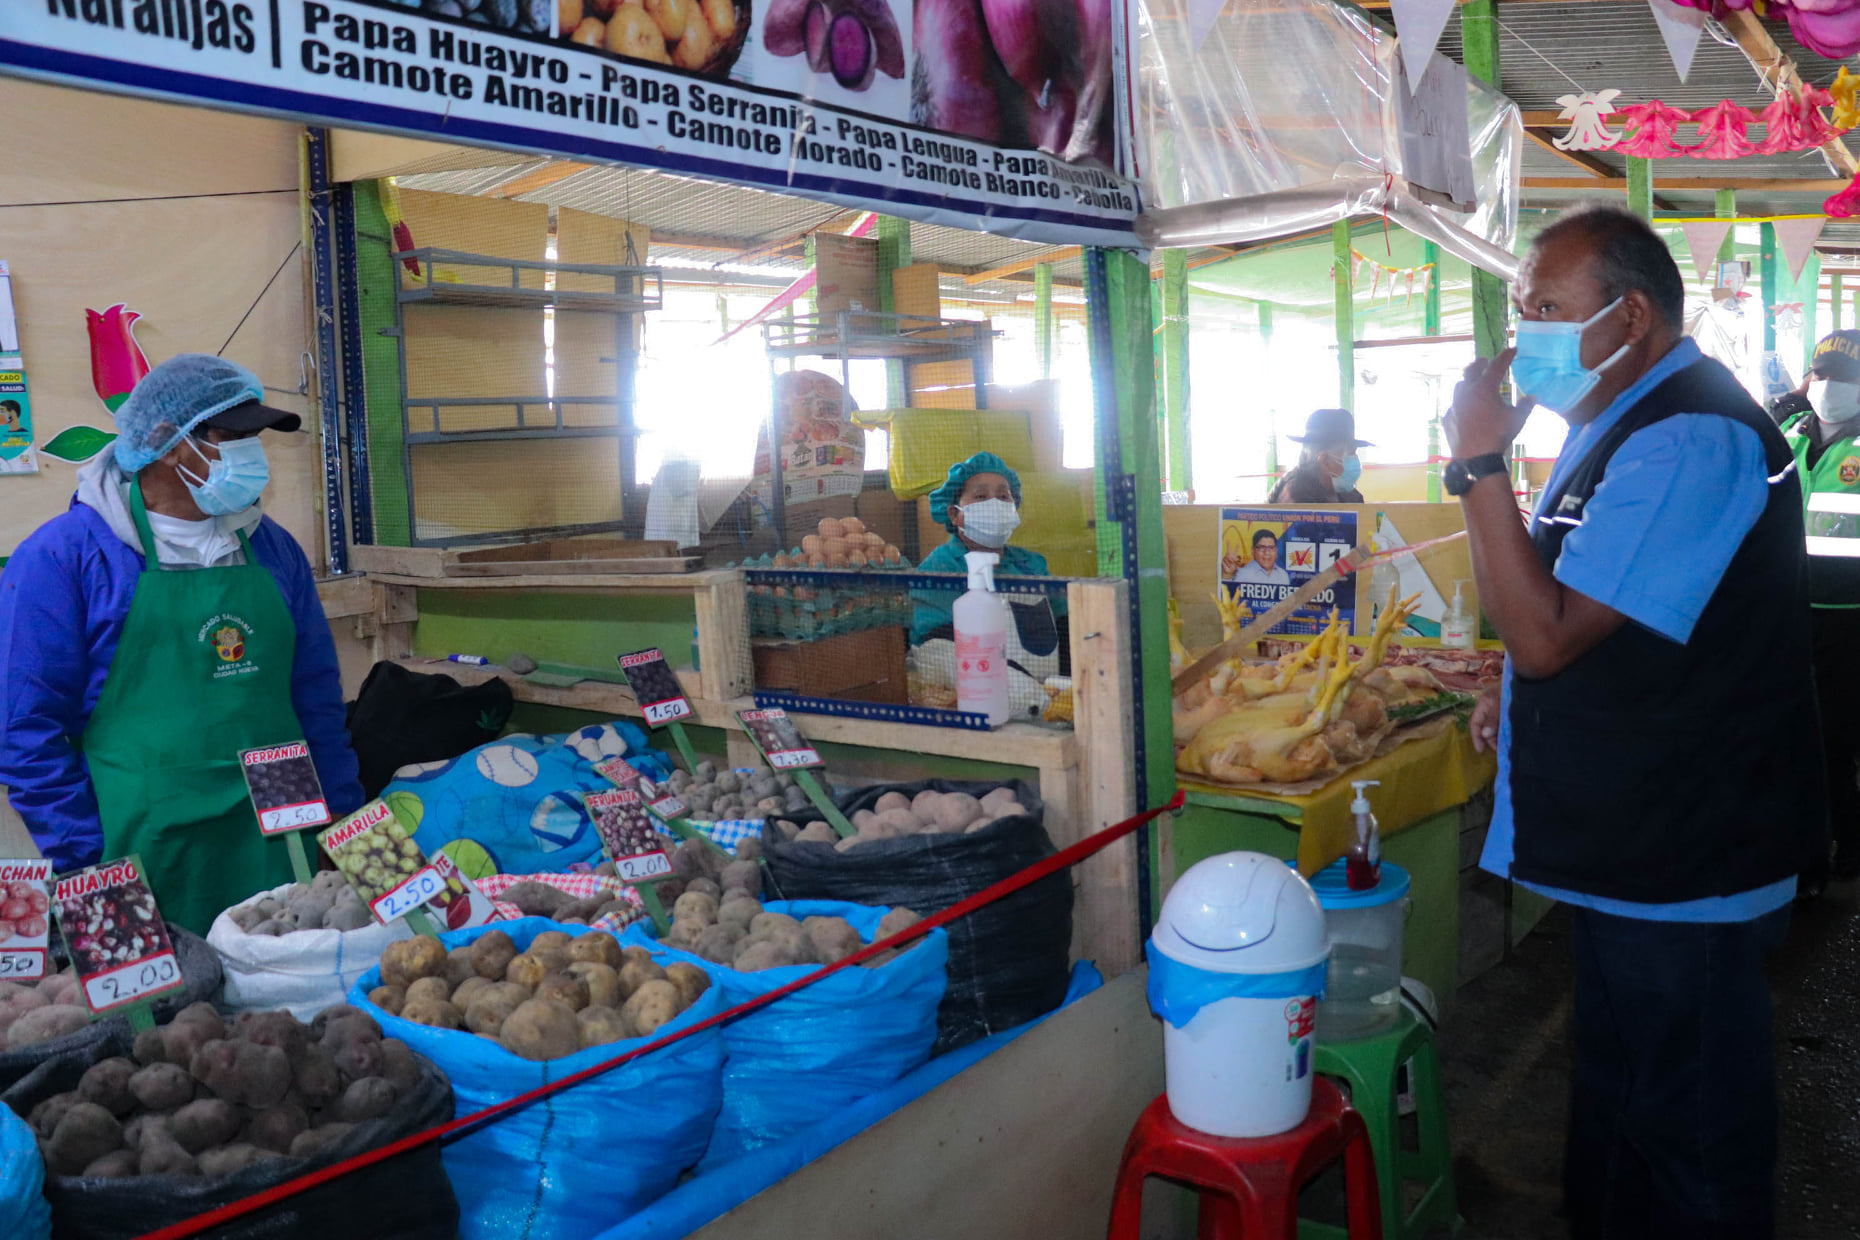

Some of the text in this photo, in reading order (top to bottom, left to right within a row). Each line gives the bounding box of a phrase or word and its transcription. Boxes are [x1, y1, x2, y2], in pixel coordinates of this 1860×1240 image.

[303, 2, 416, 54] Papa
[429, 28, 569, 84] Huayro
[601, 64, 680, 107] Papa
[837, 116, 896, 151] Papa
[901, 132, 977, 167] Lengua
[993, 152, 1048, 176] Papa
[301, 39, 473, 101] Camote
[484, 75, 639, 129] Amarillo
[667, 110, 781, 155] Camote
[901, 154, 981, 190] Camote
[985, 171, 1060, 200] Blanco
[1240, 583, 1277, 600] FREDY
[650, 703, 681, 719] 1.50
[244, 744, 308, 766] SERRANITA
[586, 790, 639, 808] PERUANITA
[326, 803, 390, 850] AMARILLA
[0, 866, 48, 881] CHAN
[57, 862, 139, 900] HUAYRO
[383, 876, 436, 916] 2.50
[102, 960, 174, 999] 2.00
